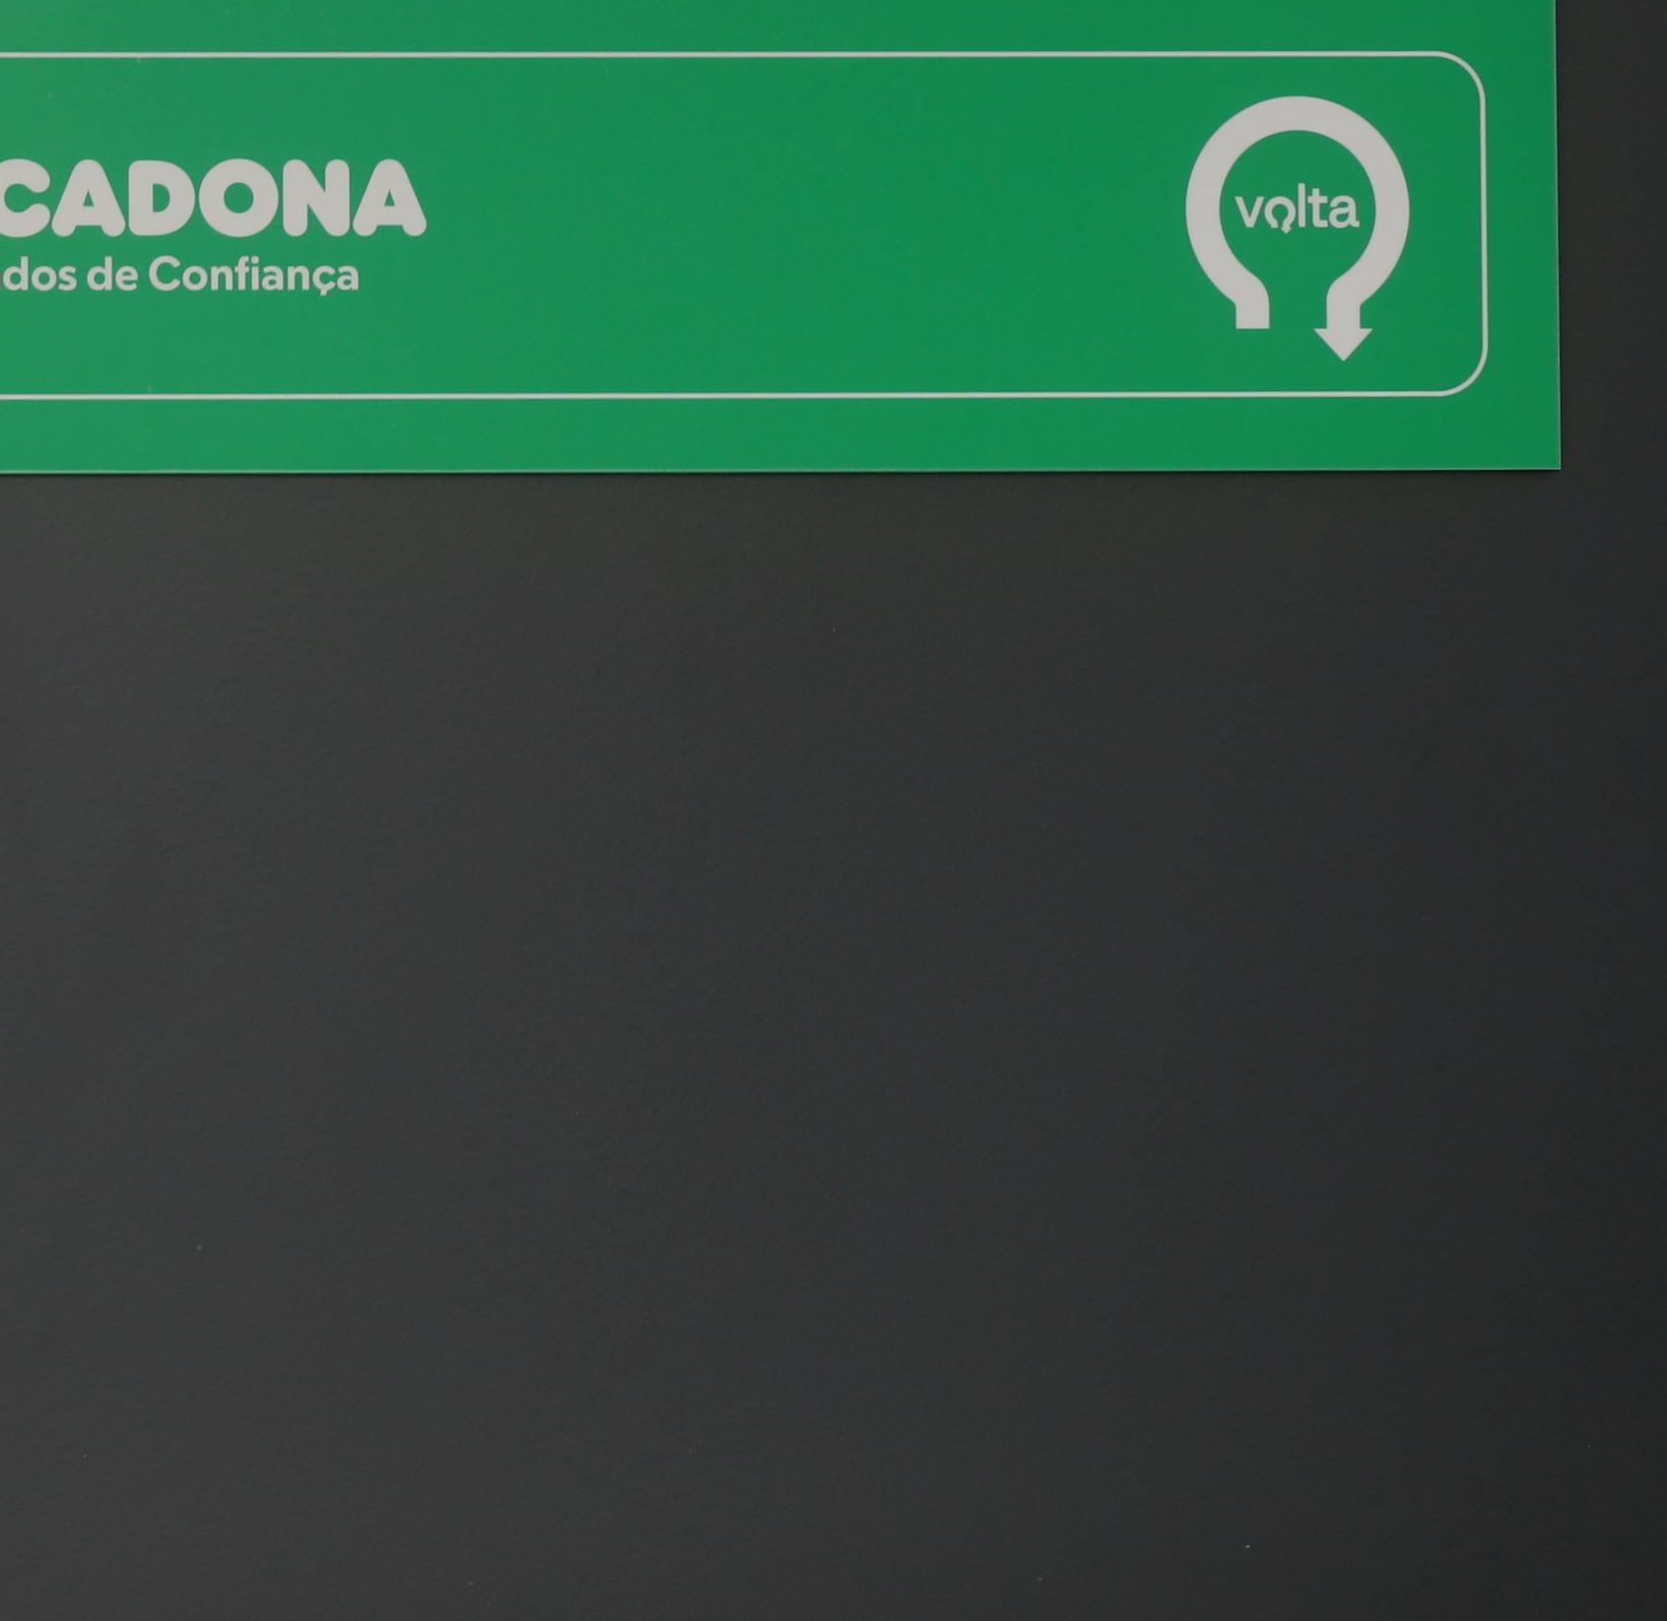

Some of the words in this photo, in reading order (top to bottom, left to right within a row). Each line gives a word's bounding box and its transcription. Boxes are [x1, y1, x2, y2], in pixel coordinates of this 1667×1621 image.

[1234, 182, 1361, 234] volta
[86, 255, 139, 291] de
[148, 255, 359, 296] Confiança
